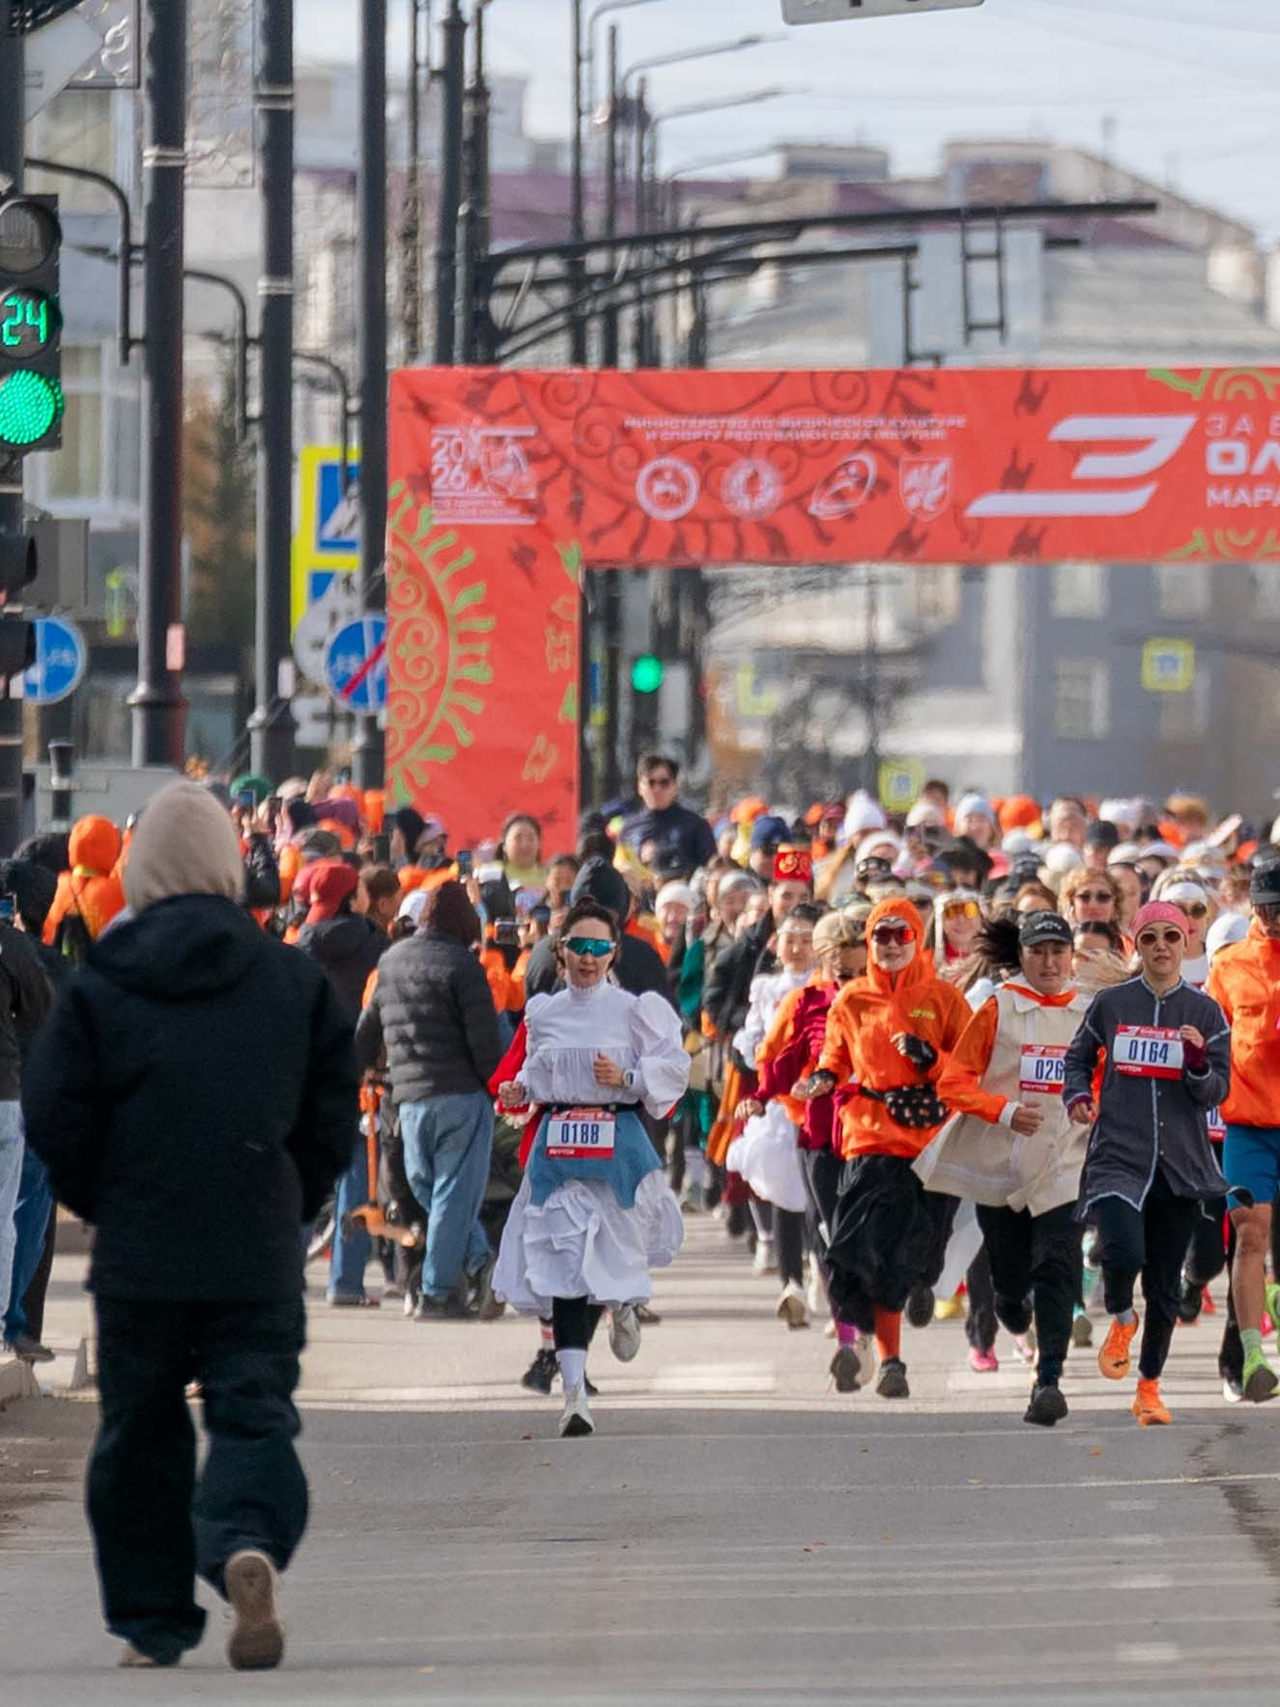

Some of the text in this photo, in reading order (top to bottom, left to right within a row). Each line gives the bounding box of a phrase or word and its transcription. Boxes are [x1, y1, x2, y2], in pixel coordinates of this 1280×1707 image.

[2, 296, 47, 346] 24
[431, 436, 463, 461] 20
[431, 463, 465, 489] 26
[1128, 1039, 1169, 1064] 0164
[1035, 1059, 1064, 1080] 026
[561, 1122, 600, 1145] 0188
